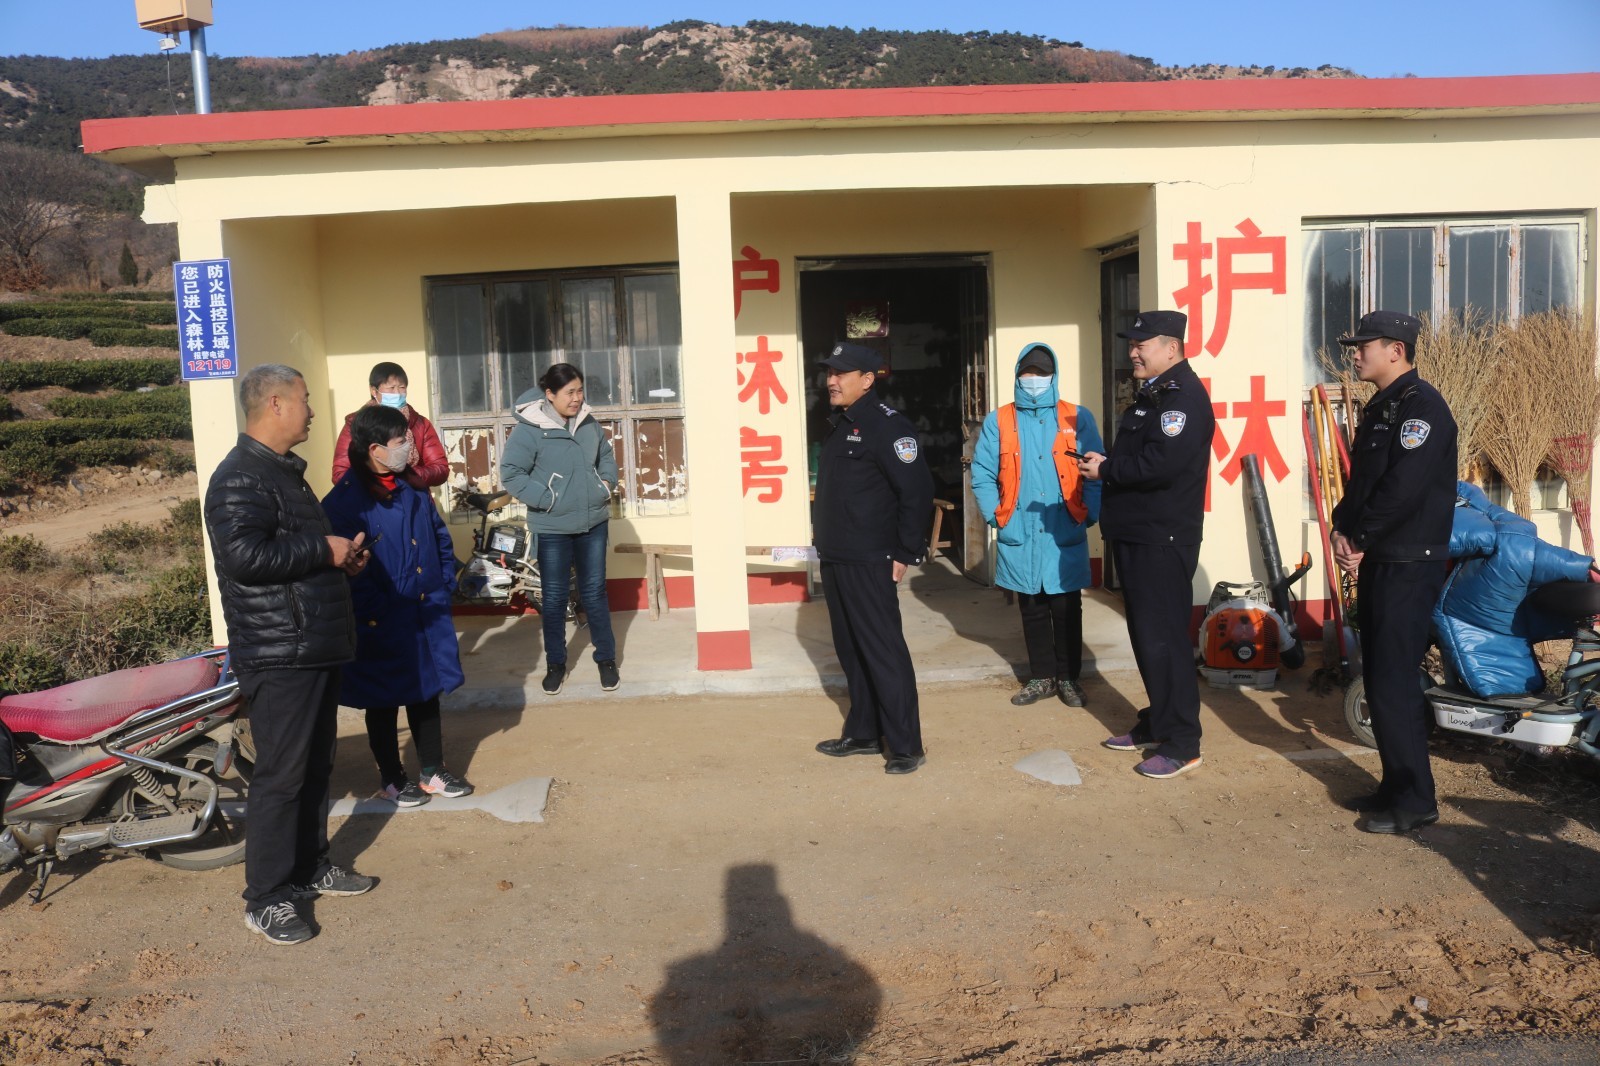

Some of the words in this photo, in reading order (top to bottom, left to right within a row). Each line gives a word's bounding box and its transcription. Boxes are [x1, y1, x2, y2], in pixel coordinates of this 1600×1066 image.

[181, 266, 204, 351] 您已进入森林
[207, 265, 230, 349] 防火监控区域
[187, 359, 231, 371] 12119
[193, 350, 225, 360] 报警电话
